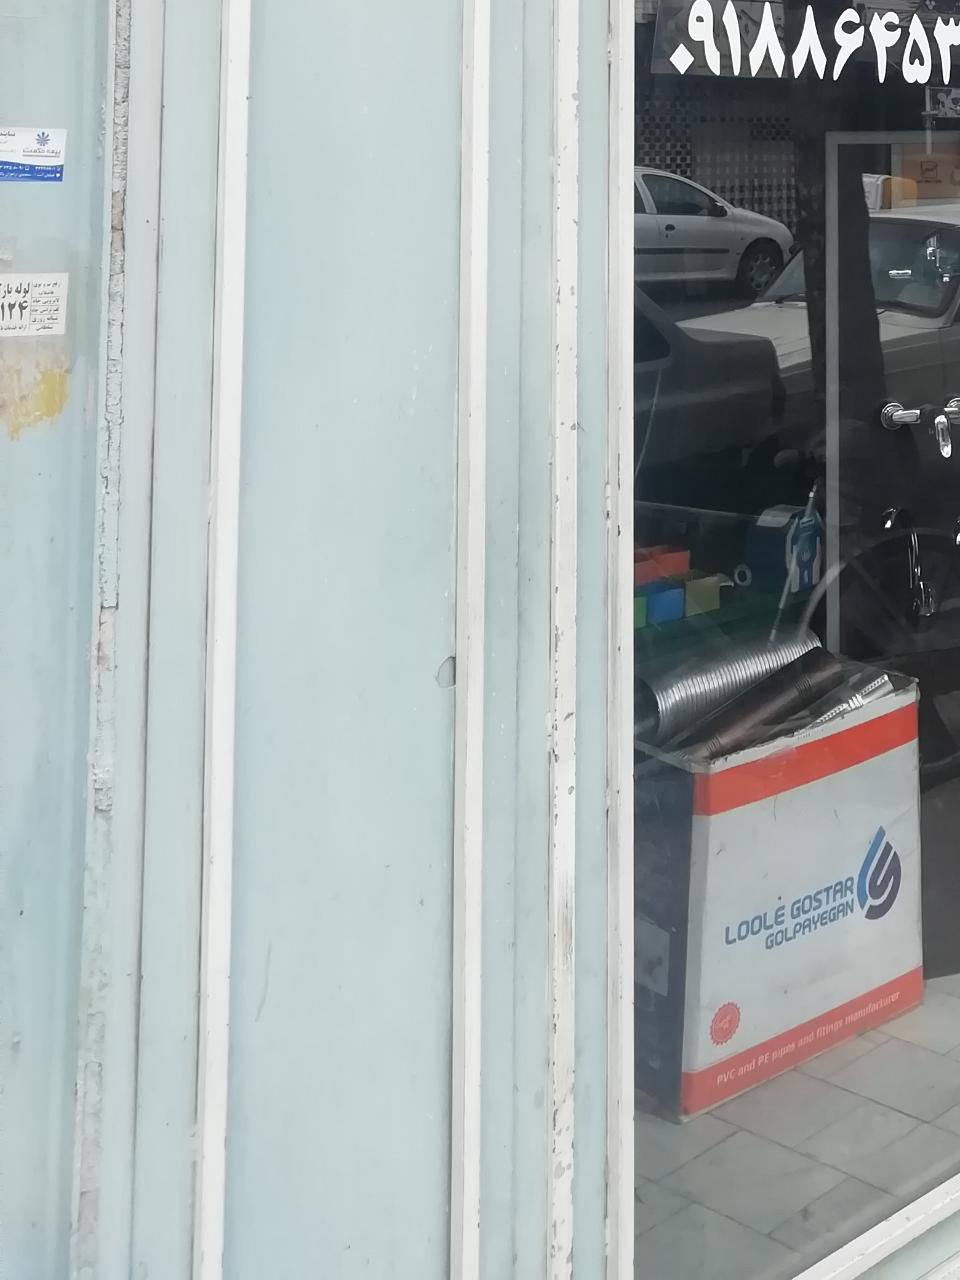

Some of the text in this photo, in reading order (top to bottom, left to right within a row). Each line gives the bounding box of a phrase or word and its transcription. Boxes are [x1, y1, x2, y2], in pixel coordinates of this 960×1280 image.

[15, 282, 30, 298] لوله
[725, 875, 855, 946] LOOLE GOSTAR
[764, 897, 855, 950] GOLPAYEGAN
[717, 1067, 737, 1086] PVC
[737, 1058, 756, 1077] and
[757, 1051, 770, 1067] PE
[772, 1041, 796, 1062] pipes
[797, 1031, 815, 1048] and
